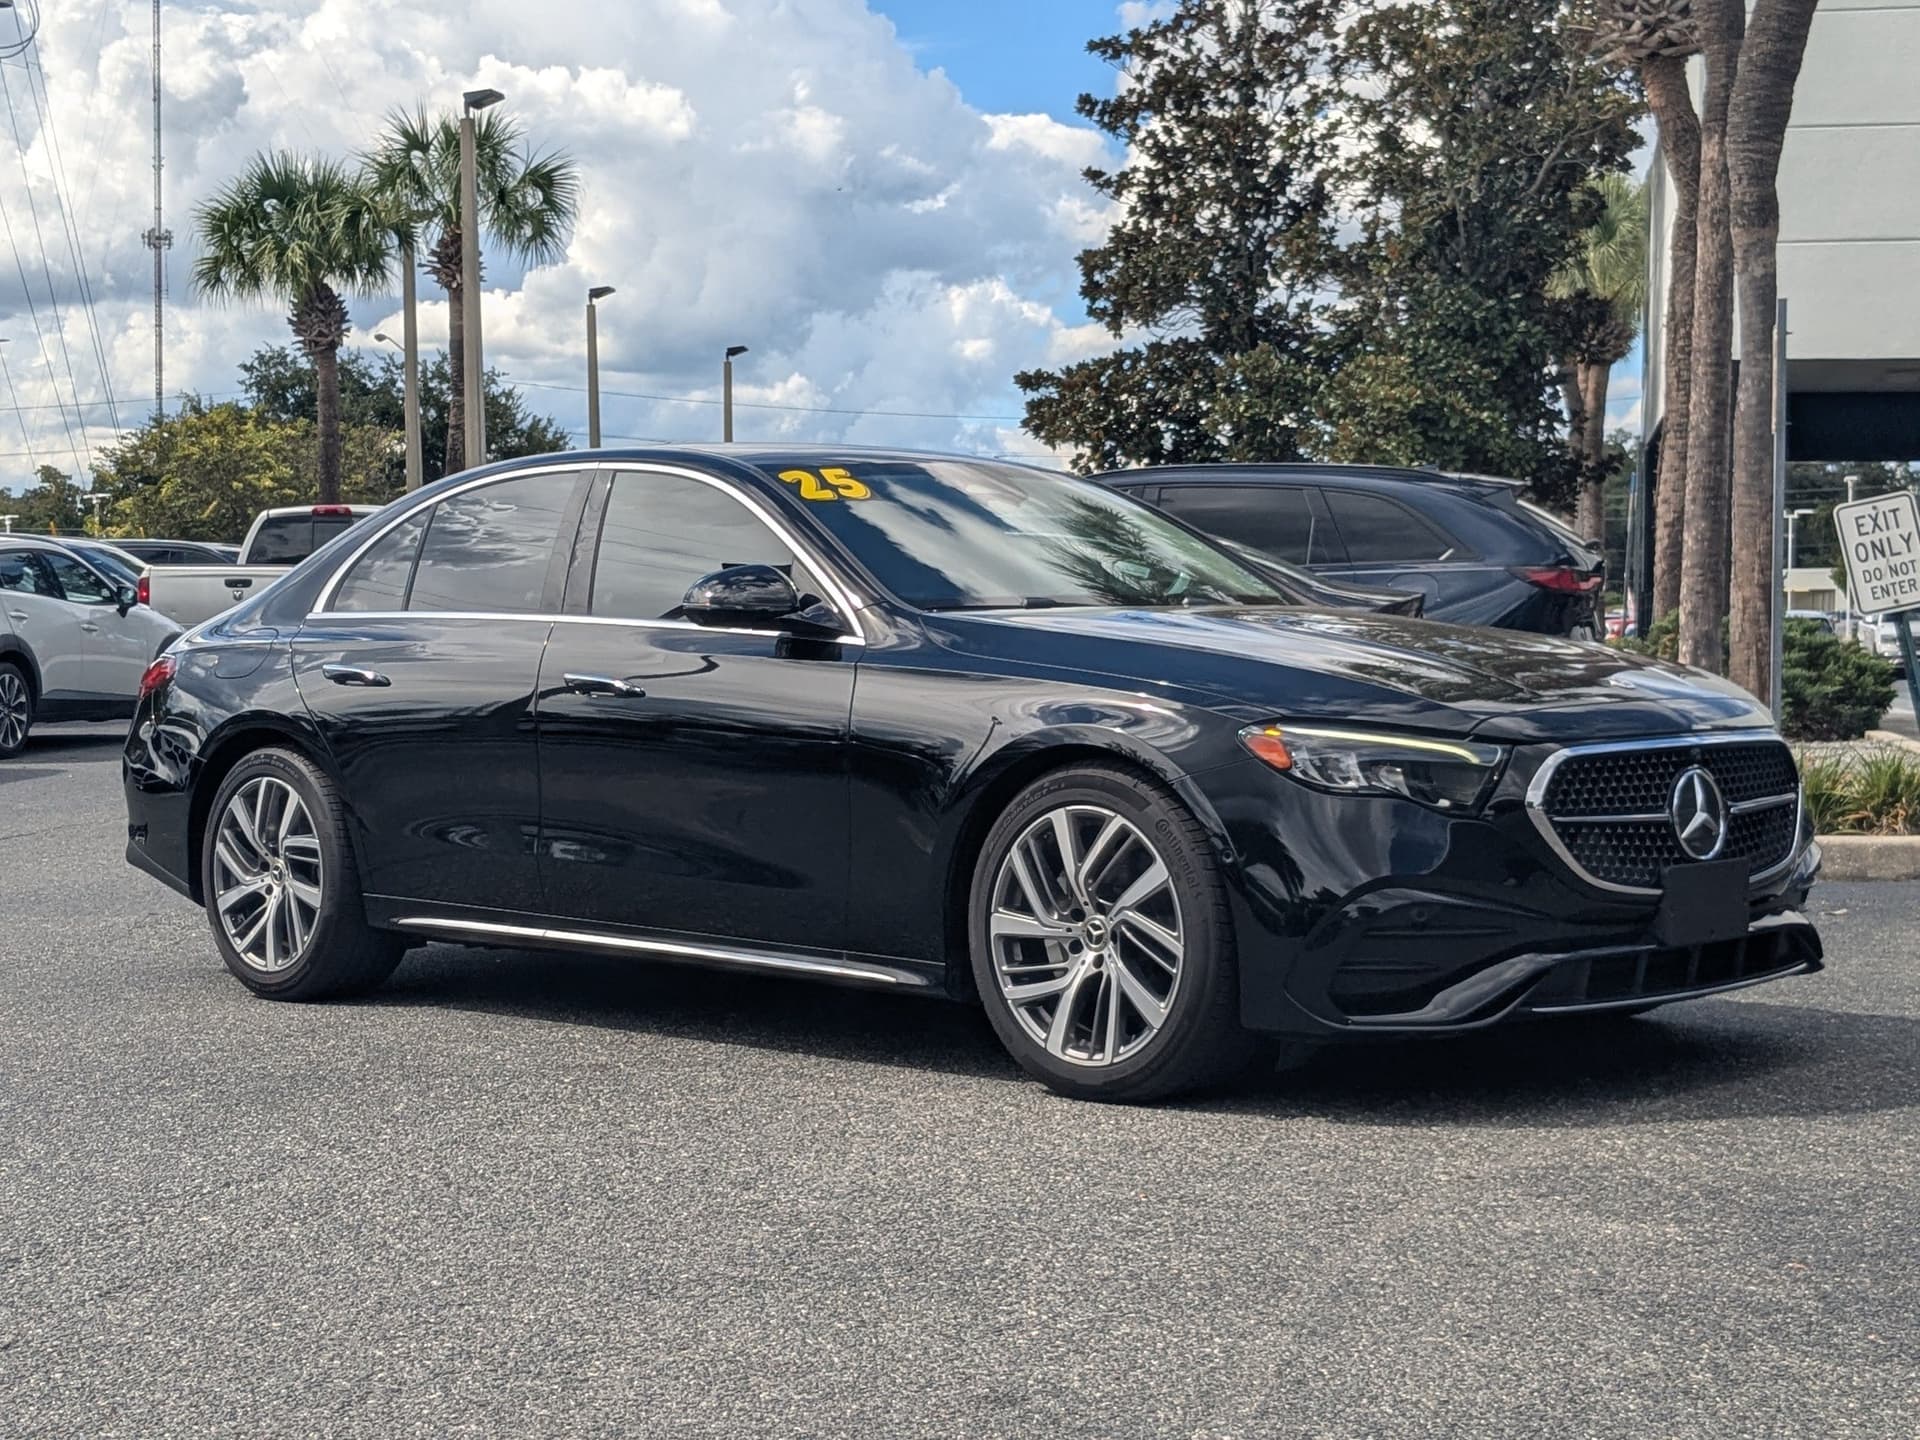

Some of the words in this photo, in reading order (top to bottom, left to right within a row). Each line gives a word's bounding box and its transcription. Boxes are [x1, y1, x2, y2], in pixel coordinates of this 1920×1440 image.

[778, 468, 872, 501] 25
[1854, 507, 1900, 537] EXIT
[1855, 531, 1913, 563] ONLY
[1862, 567, 1883, 584] DO
[1888, 559, 1917, 579] NOT
[1870, 577, 1919, 600] ENTER
